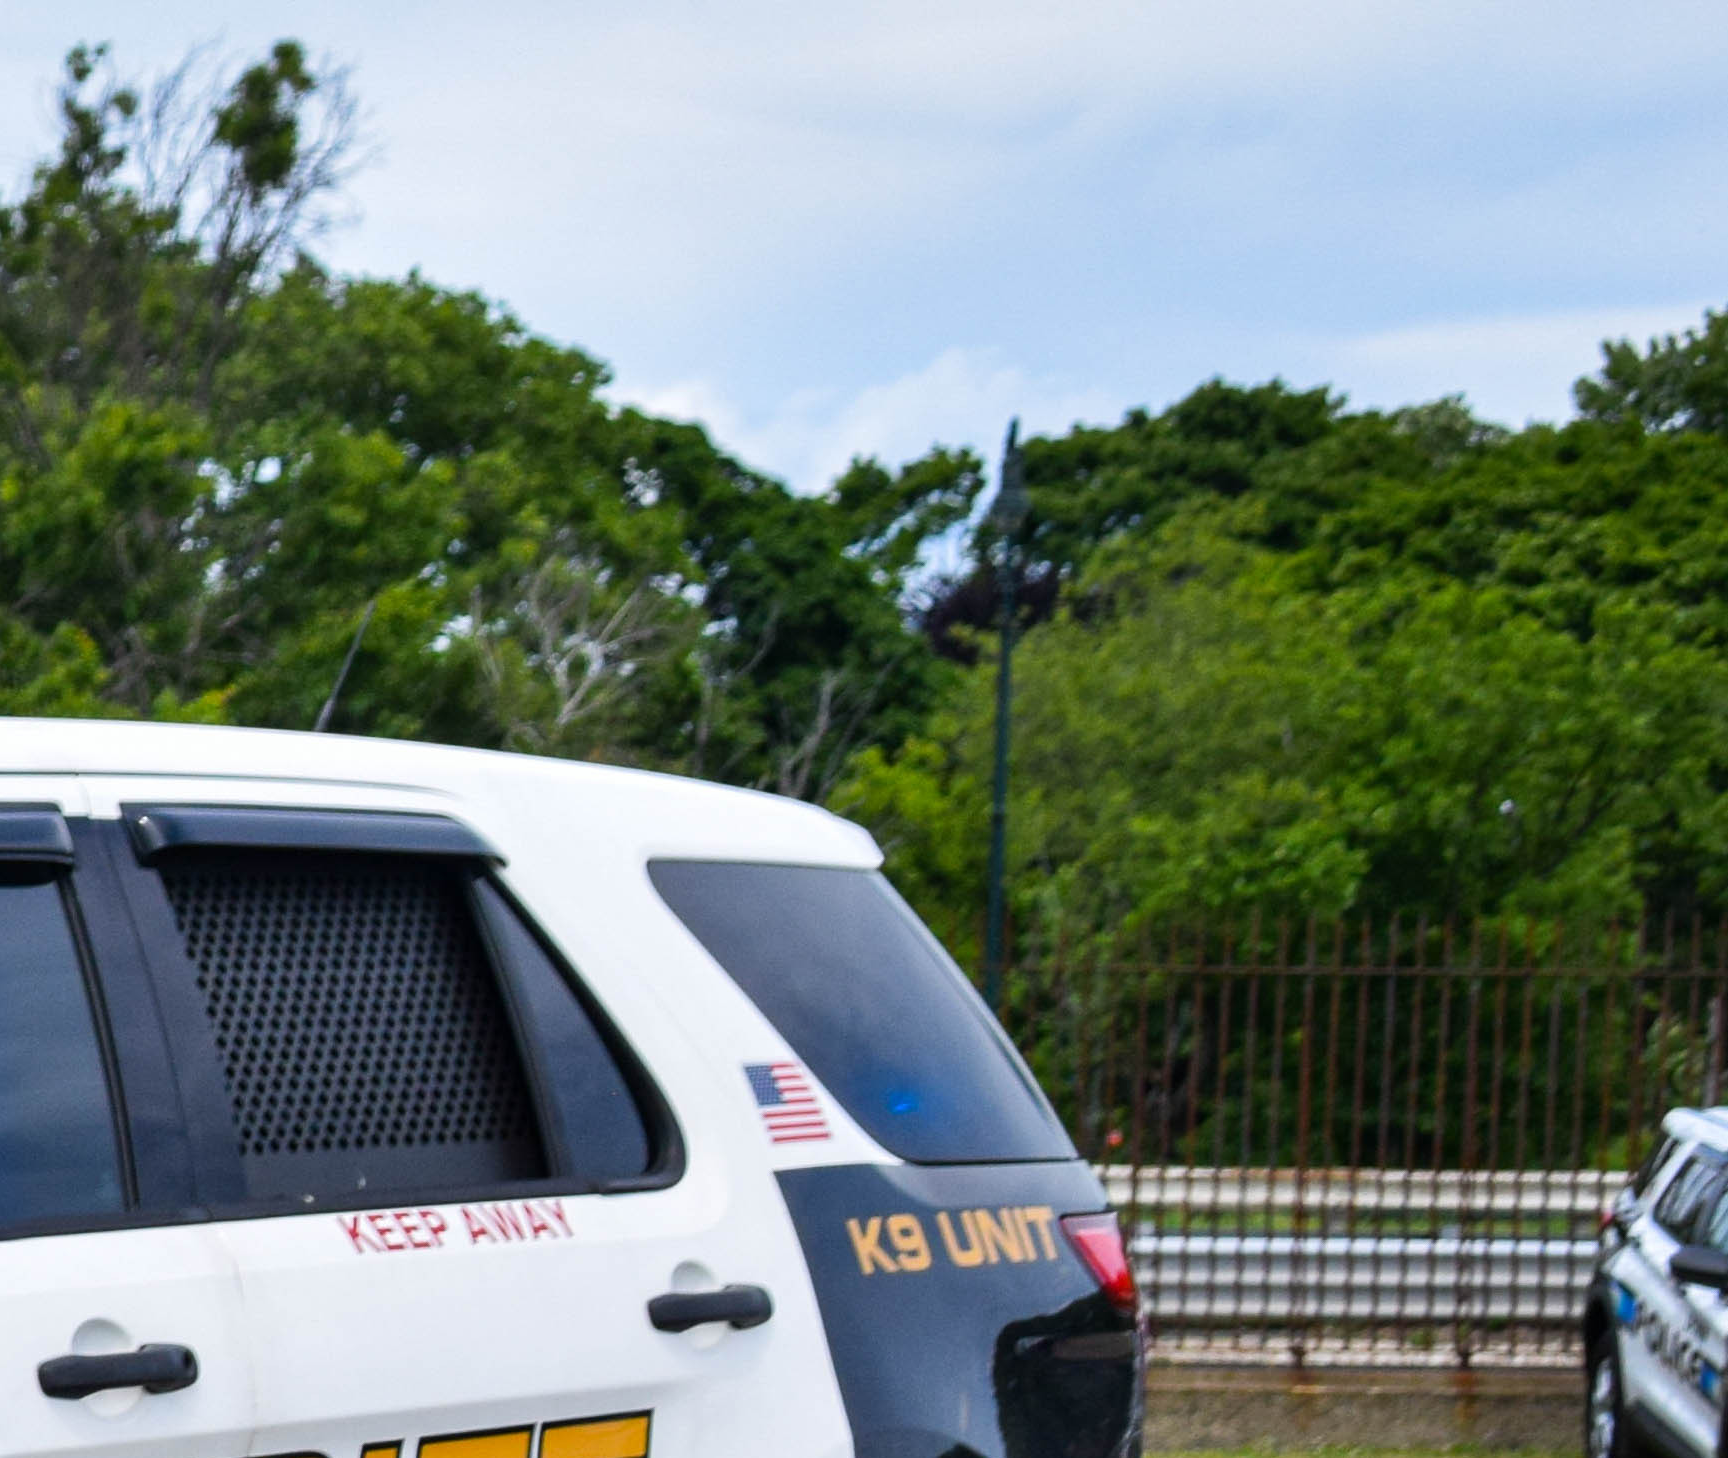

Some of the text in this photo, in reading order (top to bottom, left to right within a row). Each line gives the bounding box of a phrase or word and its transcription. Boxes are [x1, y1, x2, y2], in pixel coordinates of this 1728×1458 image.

[337, 1199, 575, 1254] KEEP AWAY
[846, 1205, 1059, 1276] K9 UNIT
